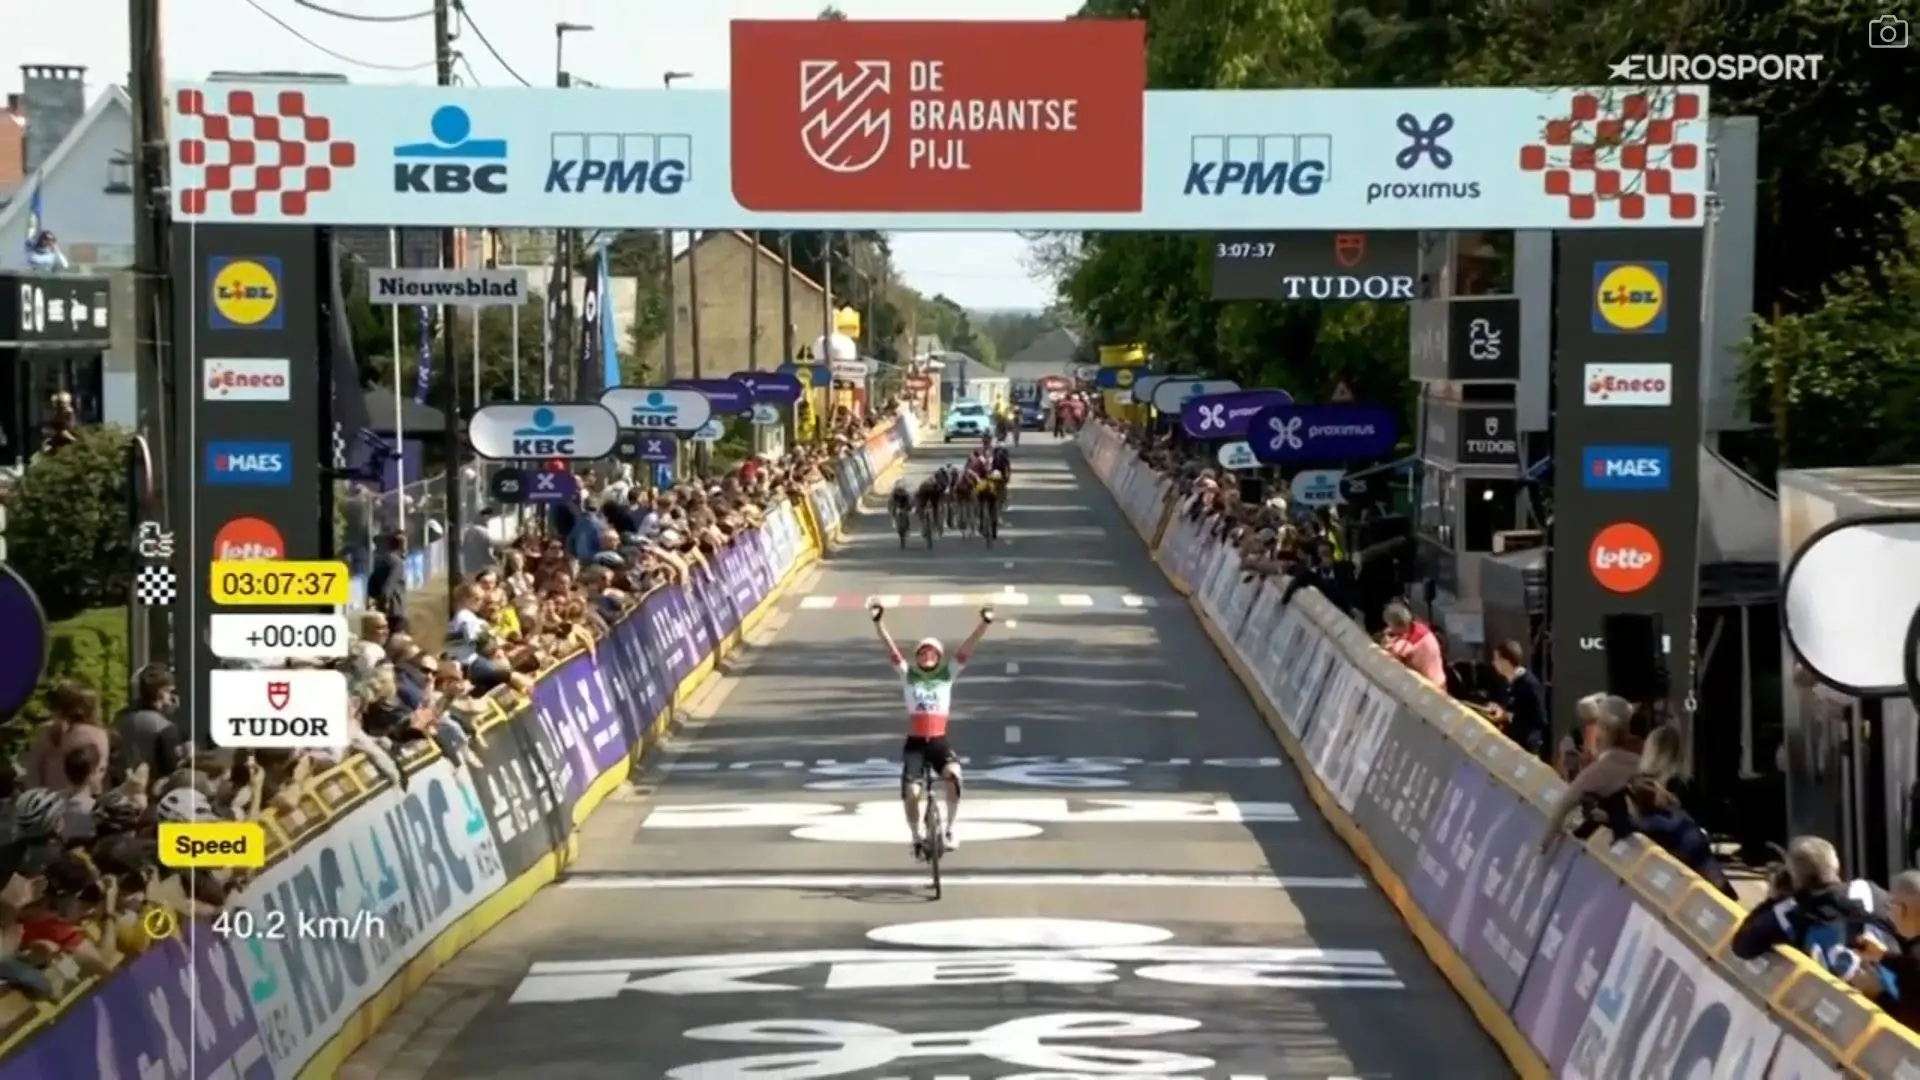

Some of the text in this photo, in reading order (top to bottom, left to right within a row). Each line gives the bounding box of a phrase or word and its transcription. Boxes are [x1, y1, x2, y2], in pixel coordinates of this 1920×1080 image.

[909, 61, 943, 92] DE
[909, 100, 1078, 131] BRABANTSE
[909, 139, 971, 170] PIJL
[393, 163, 508, 193] KBC
[544, 159, 686, 194] KPMG
[1184, 159, 1326, 195] KPMG
[1367, 181, 1481, 204] proximus
[1216, 243, 1276, 258] 3:07:37
[378, 276, 519, 297] Nieuwsblad
[1283, 276, 1415, 299] TUDOR
[224, 371, 285, 387] Eneco
[1605, 376, 1666, 393] Eneco
[632, 413, 678, 427] KBC
[1308, 424, 1376, 439] proximus
[513, 439, 575, 456] KBC
[1468, 440, 1516, 453] TUDOR
[228, 454, 283, 473] MAES
[1606, 459, 1661, 477] MAES
[1596, 546, 1653, 569] lotto
